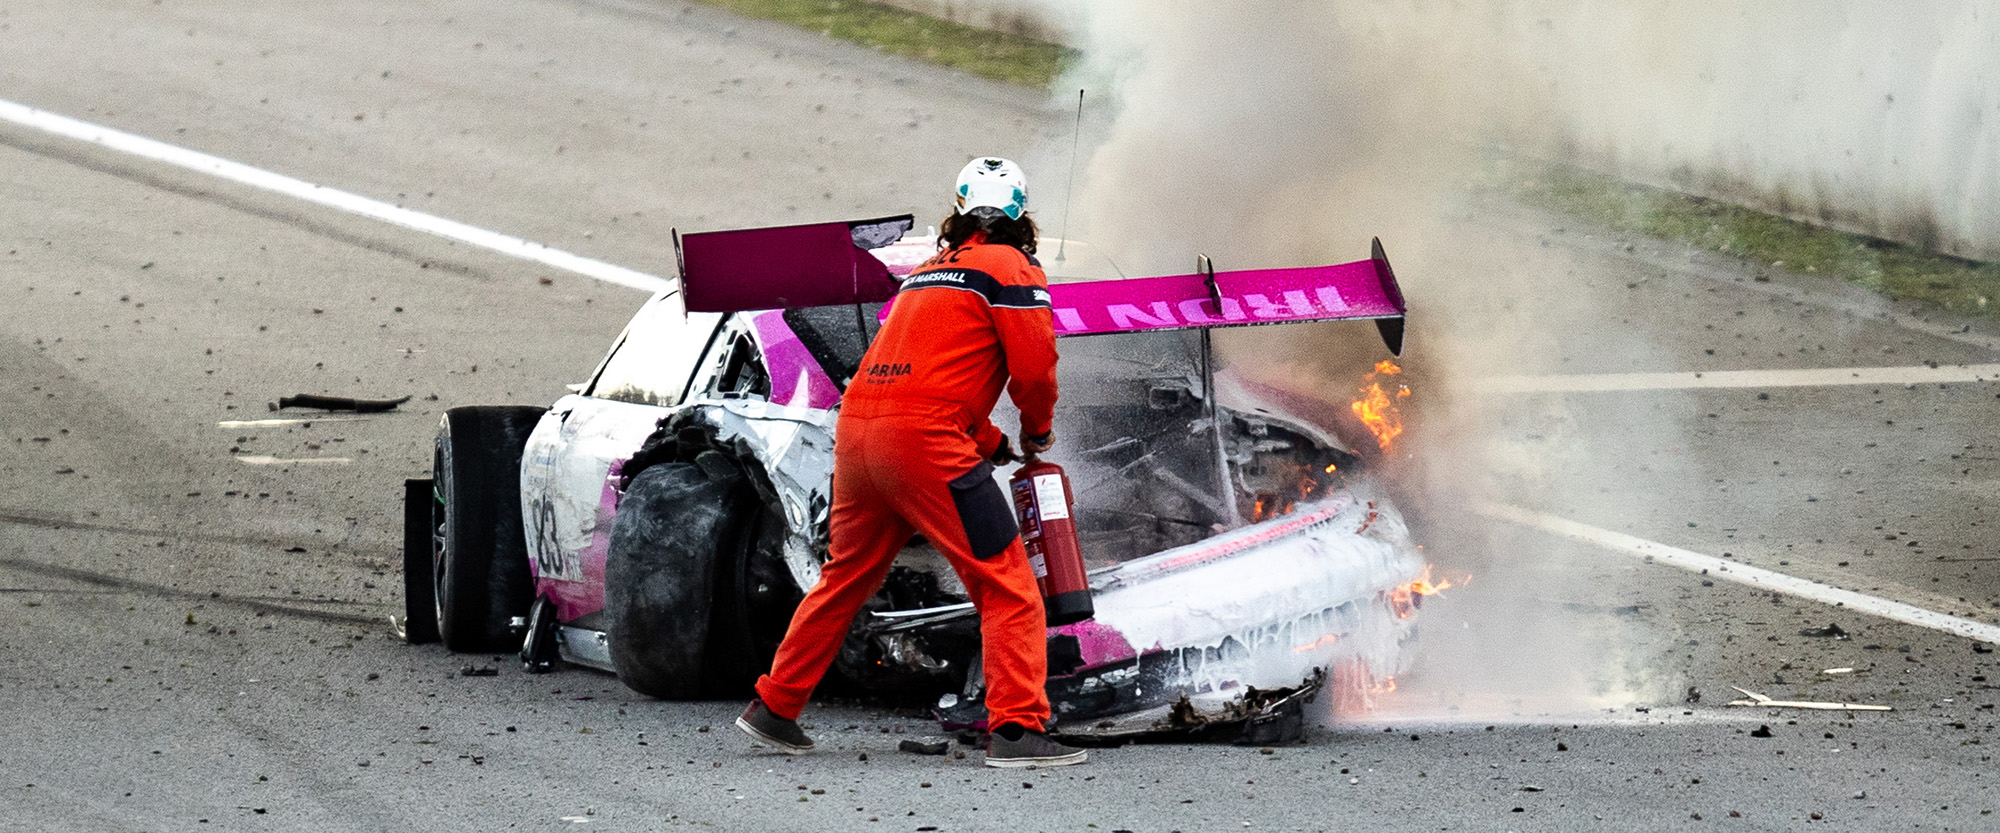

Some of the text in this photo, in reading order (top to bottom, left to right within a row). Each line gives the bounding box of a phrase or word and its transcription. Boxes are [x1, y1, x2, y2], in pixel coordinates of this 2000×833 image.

[1107, 285, 1349, 328] IRON
[867, 363, 911, 377] ARNA
[532, 498, 563, 575] 83
